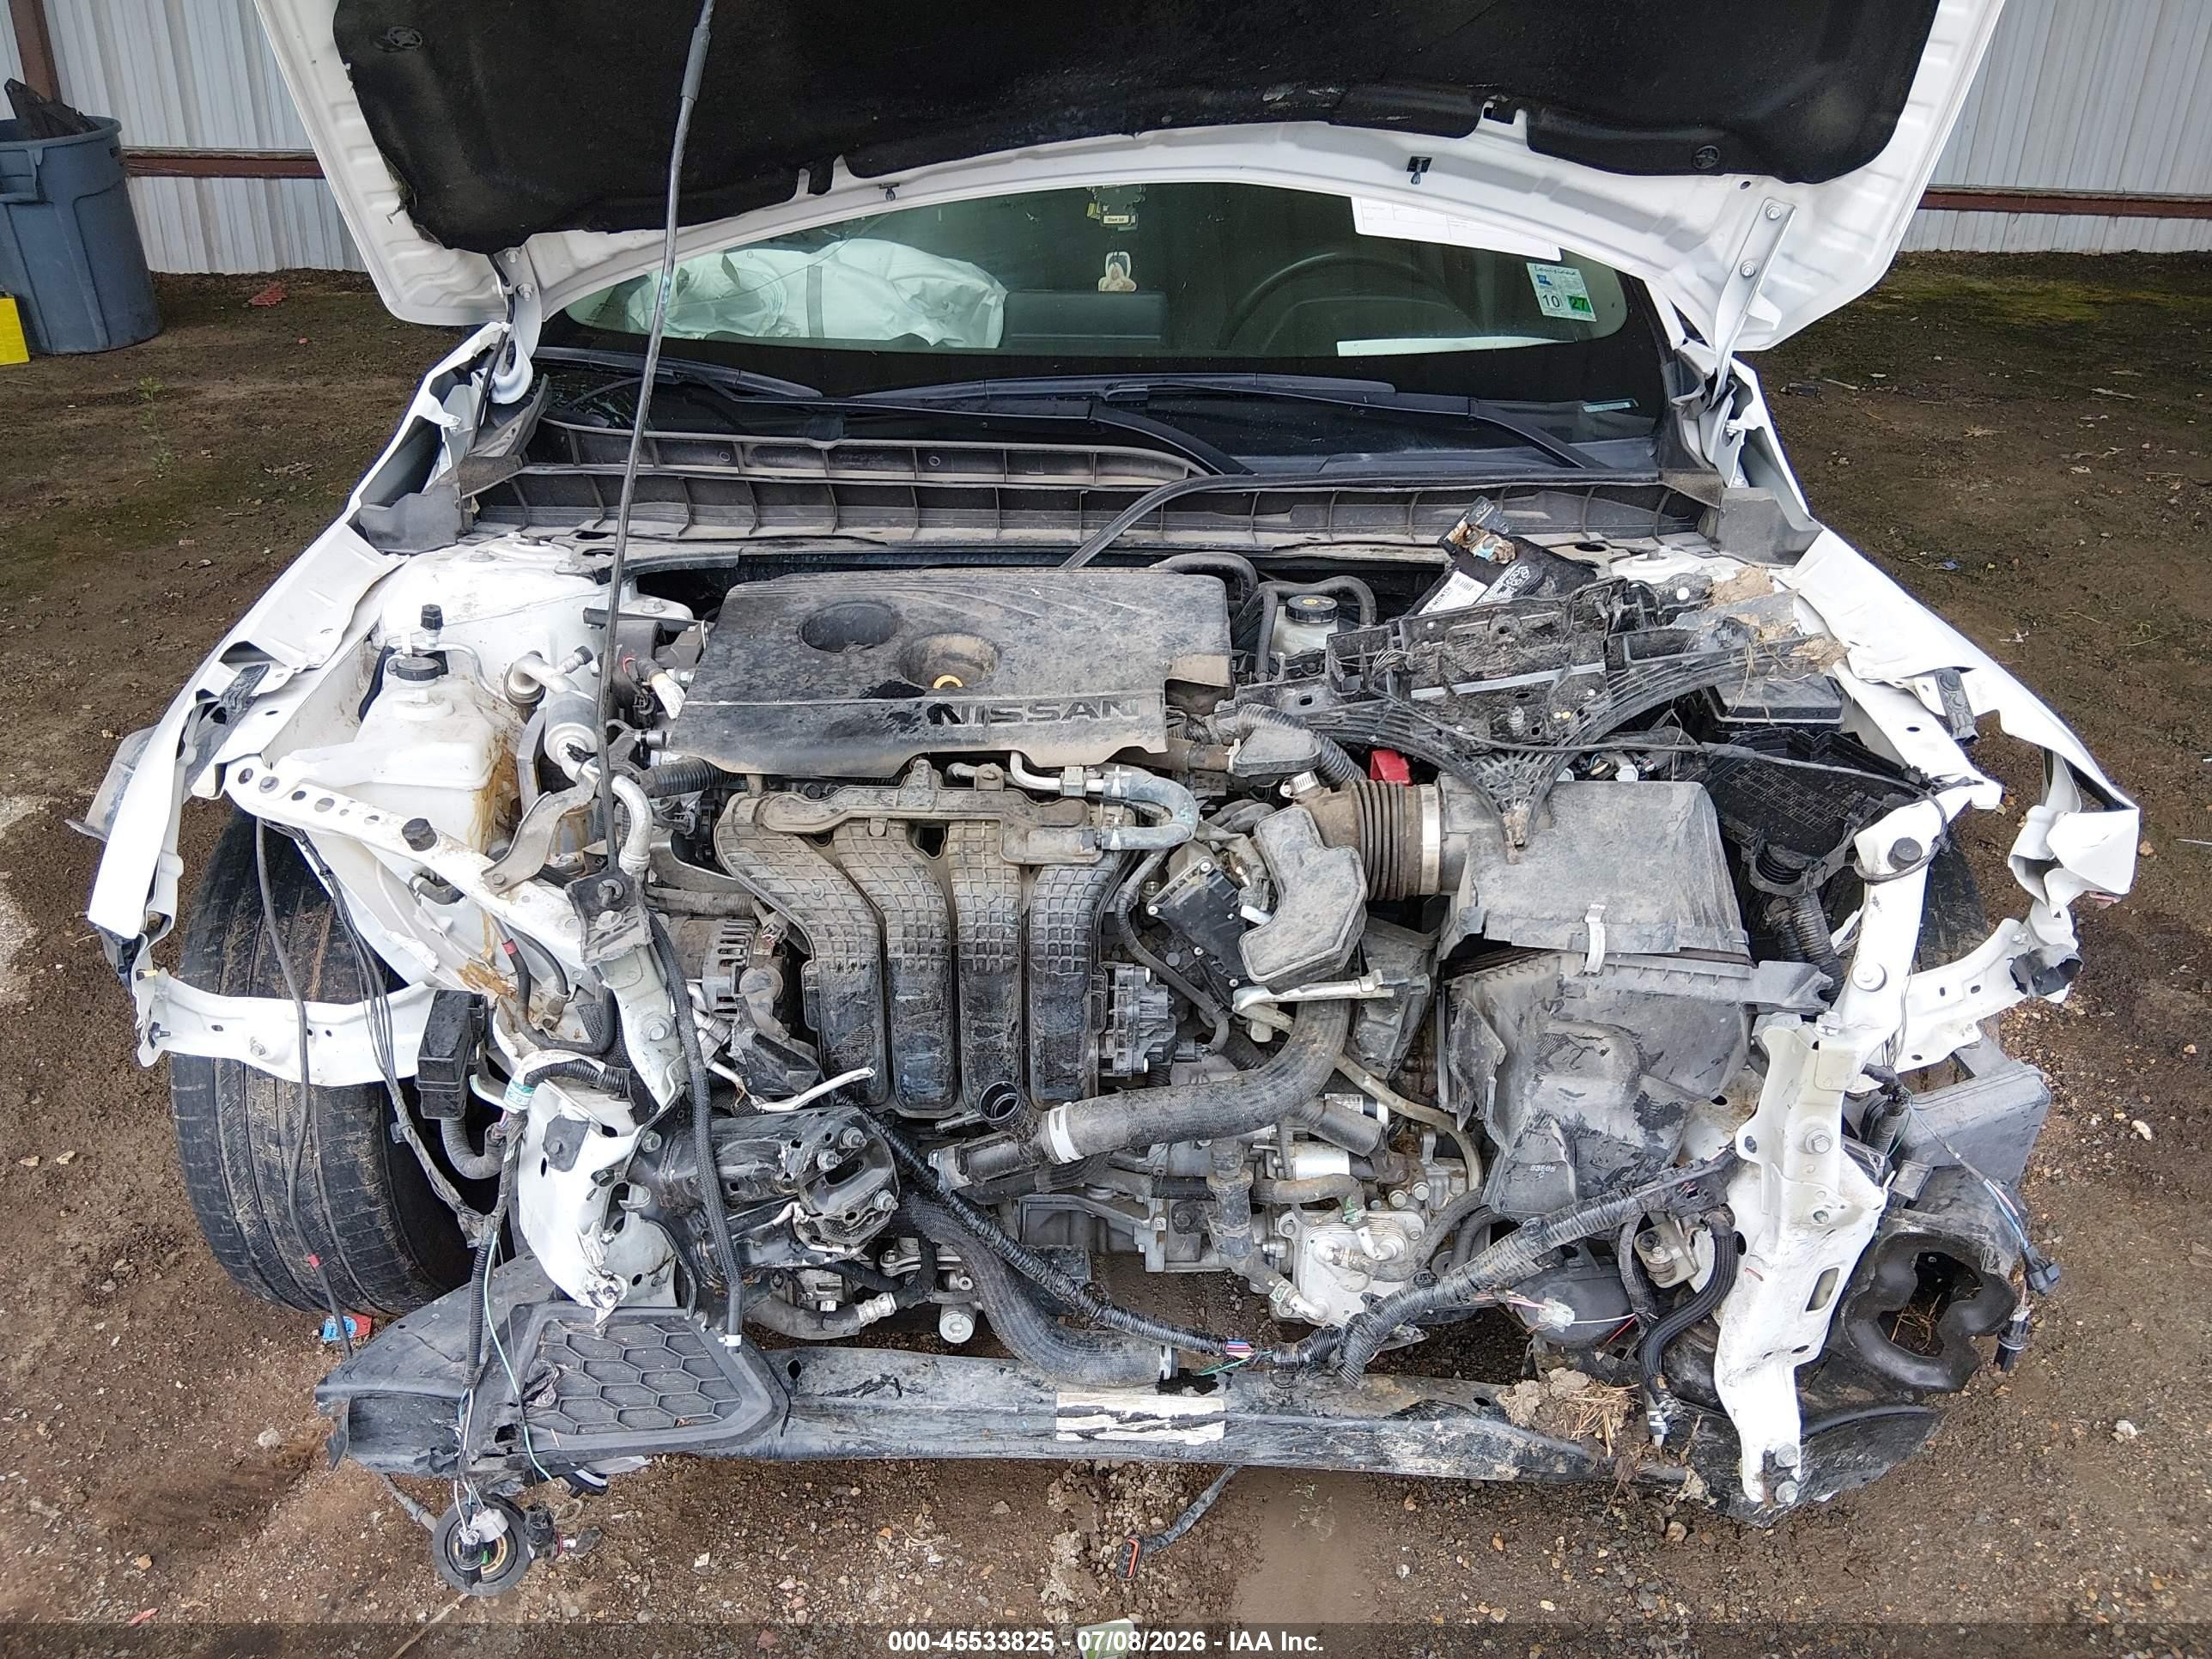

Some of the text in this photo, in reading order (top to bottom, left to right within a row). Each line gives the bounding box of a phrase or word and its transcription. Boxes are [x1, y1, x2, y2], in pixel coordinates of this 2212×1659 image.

[1542, 294, 1589, 311] 10 27
[928, 700, 1140, 728] NISSAN
